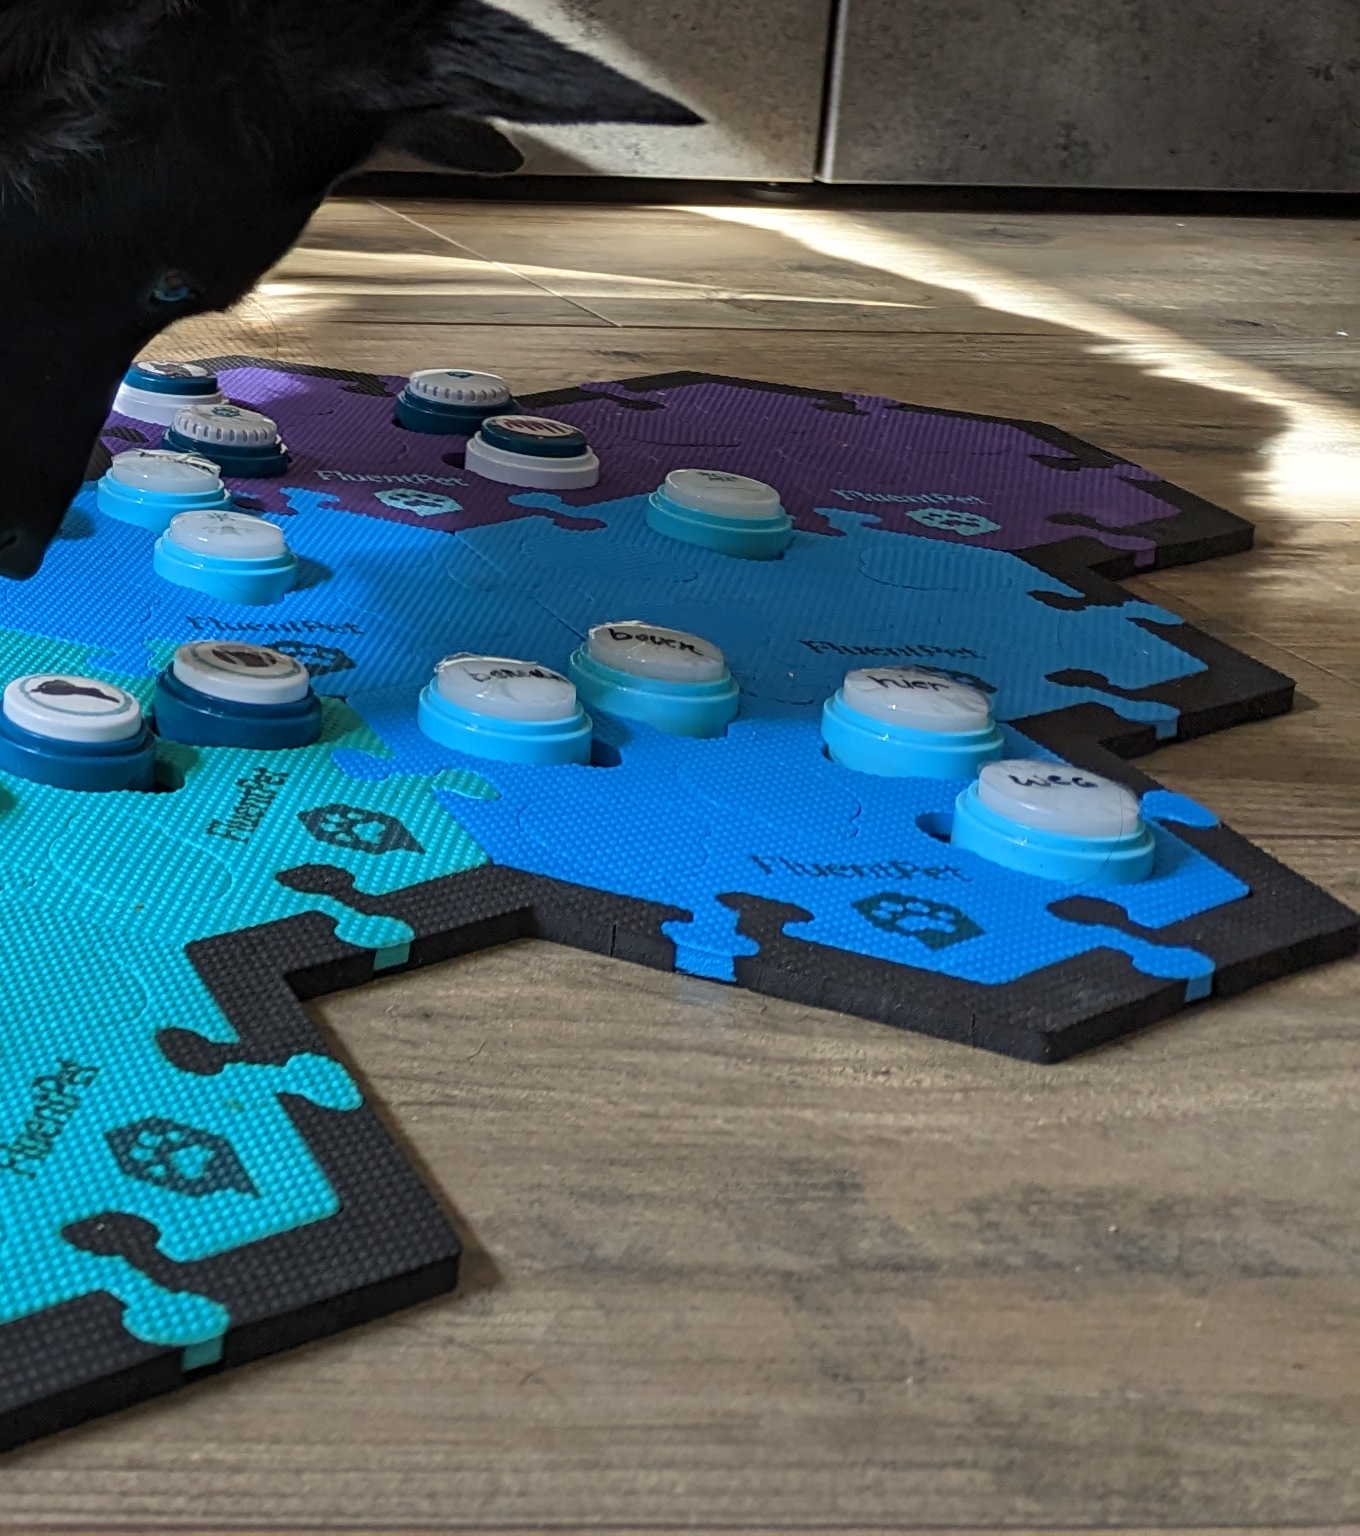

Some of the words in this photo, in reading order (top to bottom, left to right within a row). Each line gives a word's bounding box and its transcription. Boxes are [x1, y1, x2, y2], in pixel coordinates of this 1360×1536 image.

[313, 469, 470, 487] FluentPet
[830, 488, 993, 505] FluentPet
[186, 615, 365, 637] FluentPet
[798, 639, 986, 660] FluentPet
[867, 674, 950, 692] hier
[751, 855, 974, 884] FluentPet
